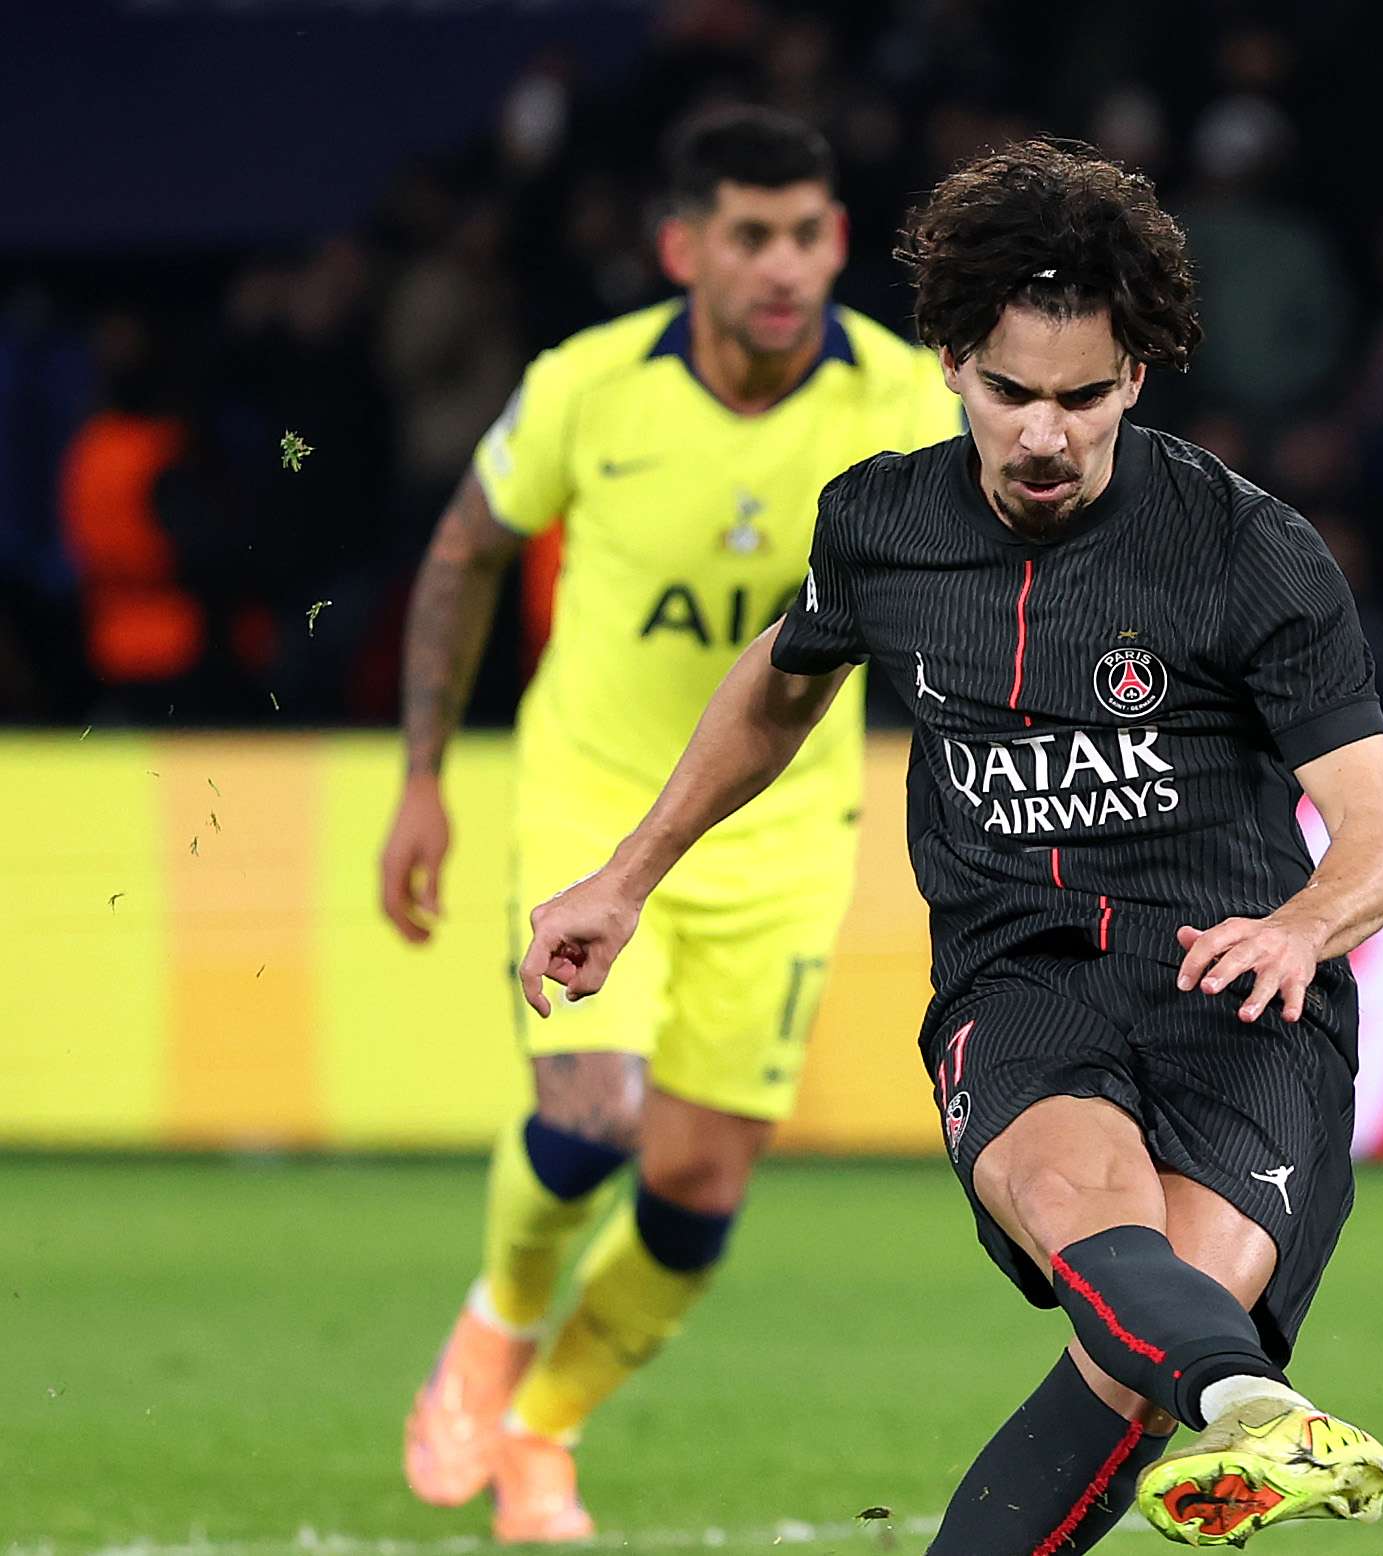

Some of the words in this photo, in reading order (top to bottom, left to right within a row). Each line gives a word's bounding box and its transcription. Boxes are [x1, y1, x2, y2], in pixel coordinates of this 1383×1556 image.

[1104, 651, 1152, 667] PARIS
[943, 727, 1173, 808] QATAR
[984, 777, 1180, 834] AIRWAYS
